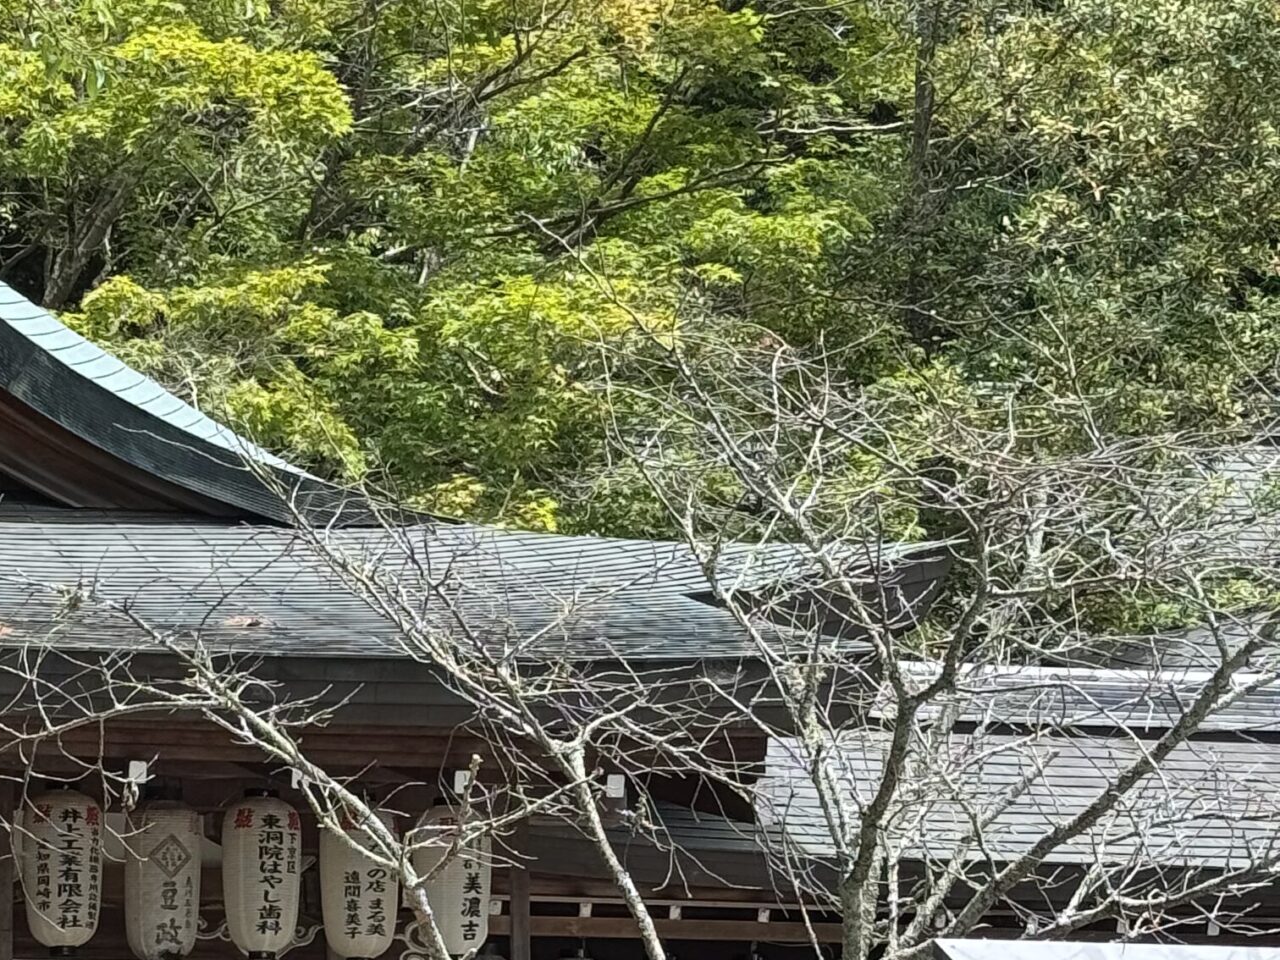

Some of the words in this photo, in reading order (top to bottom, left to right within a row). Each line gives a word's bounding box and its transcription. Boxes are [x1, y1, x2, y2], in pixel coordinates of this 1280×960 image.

[57, 807, 84, 929] 井上工業有限会社
[256, 814, 284, 936] 東洞院はやし歯科
[287, 832, 297, 875] 下京区
[154, 880, 183, 946] 豆政
[460, 872, 483, 941] 美濃吉
